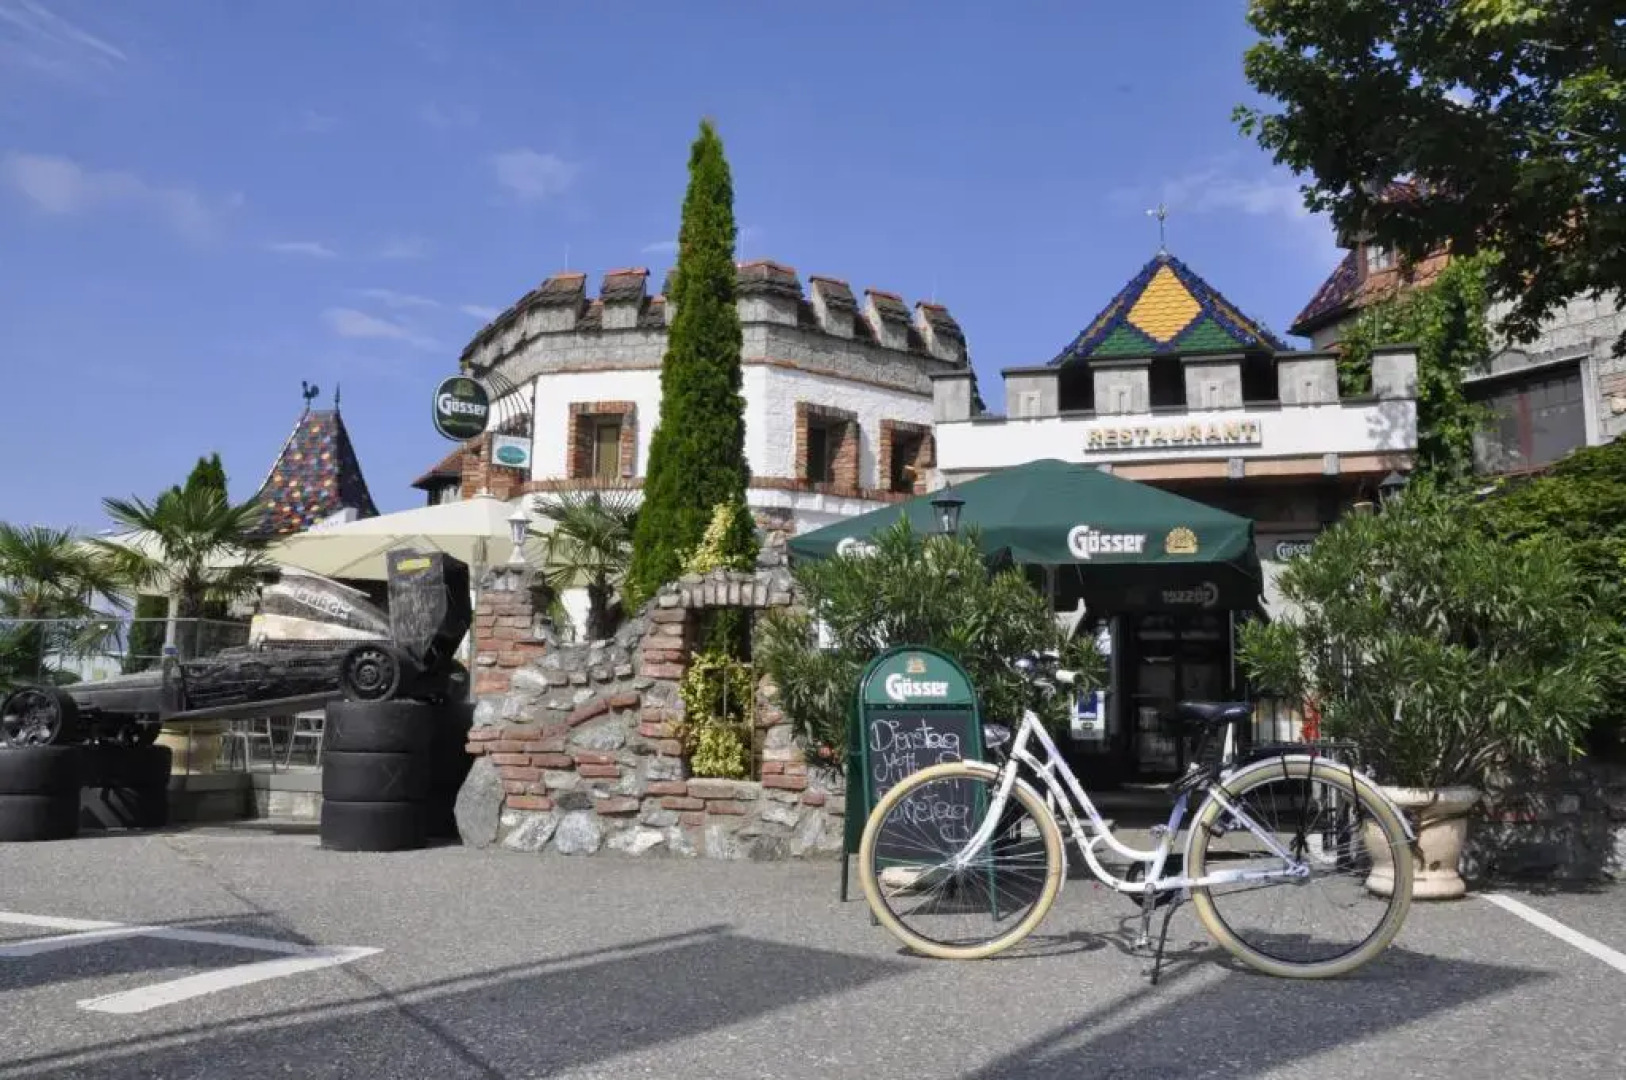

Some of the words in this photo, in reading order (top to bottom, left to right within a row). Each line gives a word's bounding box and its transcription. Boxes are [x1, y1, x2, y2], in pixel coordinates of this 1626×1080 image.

[1087, 419, 1258, 448] RESTAURANT
[1067, 525, 1146, 560] Gösser
[885, 673, 949, 702] Gösser
